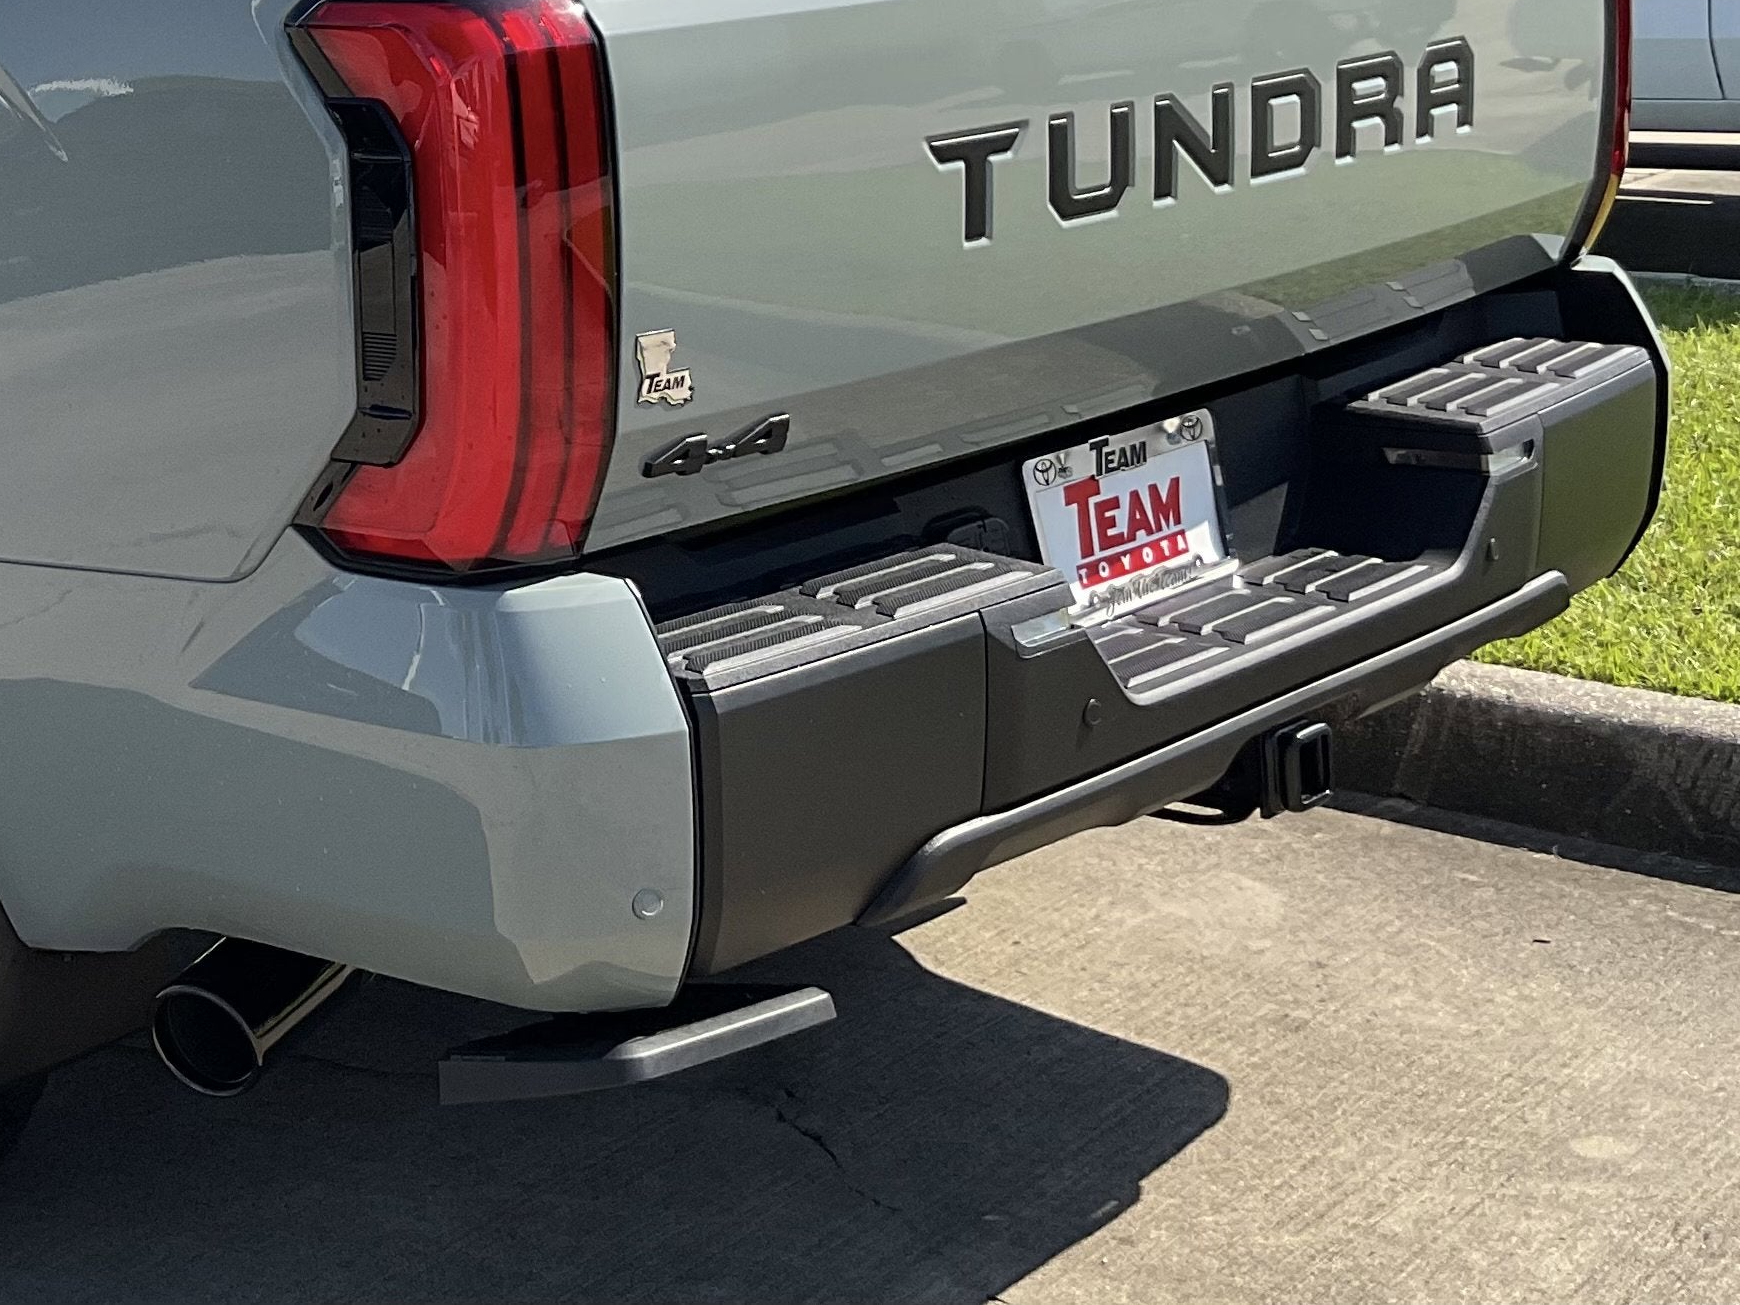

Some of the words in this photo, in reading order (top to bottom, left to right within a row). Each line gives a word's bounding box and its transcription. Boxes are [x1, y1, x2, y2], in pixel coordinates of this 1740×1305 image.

[924, 35, 1474, 249] TUNDRA
[644, 372, 686, 395] TEAM
[1089, 437, 1148, 477] TEAM
[1063, 476, 1182, 559] TEAM
[1079, 536, 1188, 585] TOYOTA
